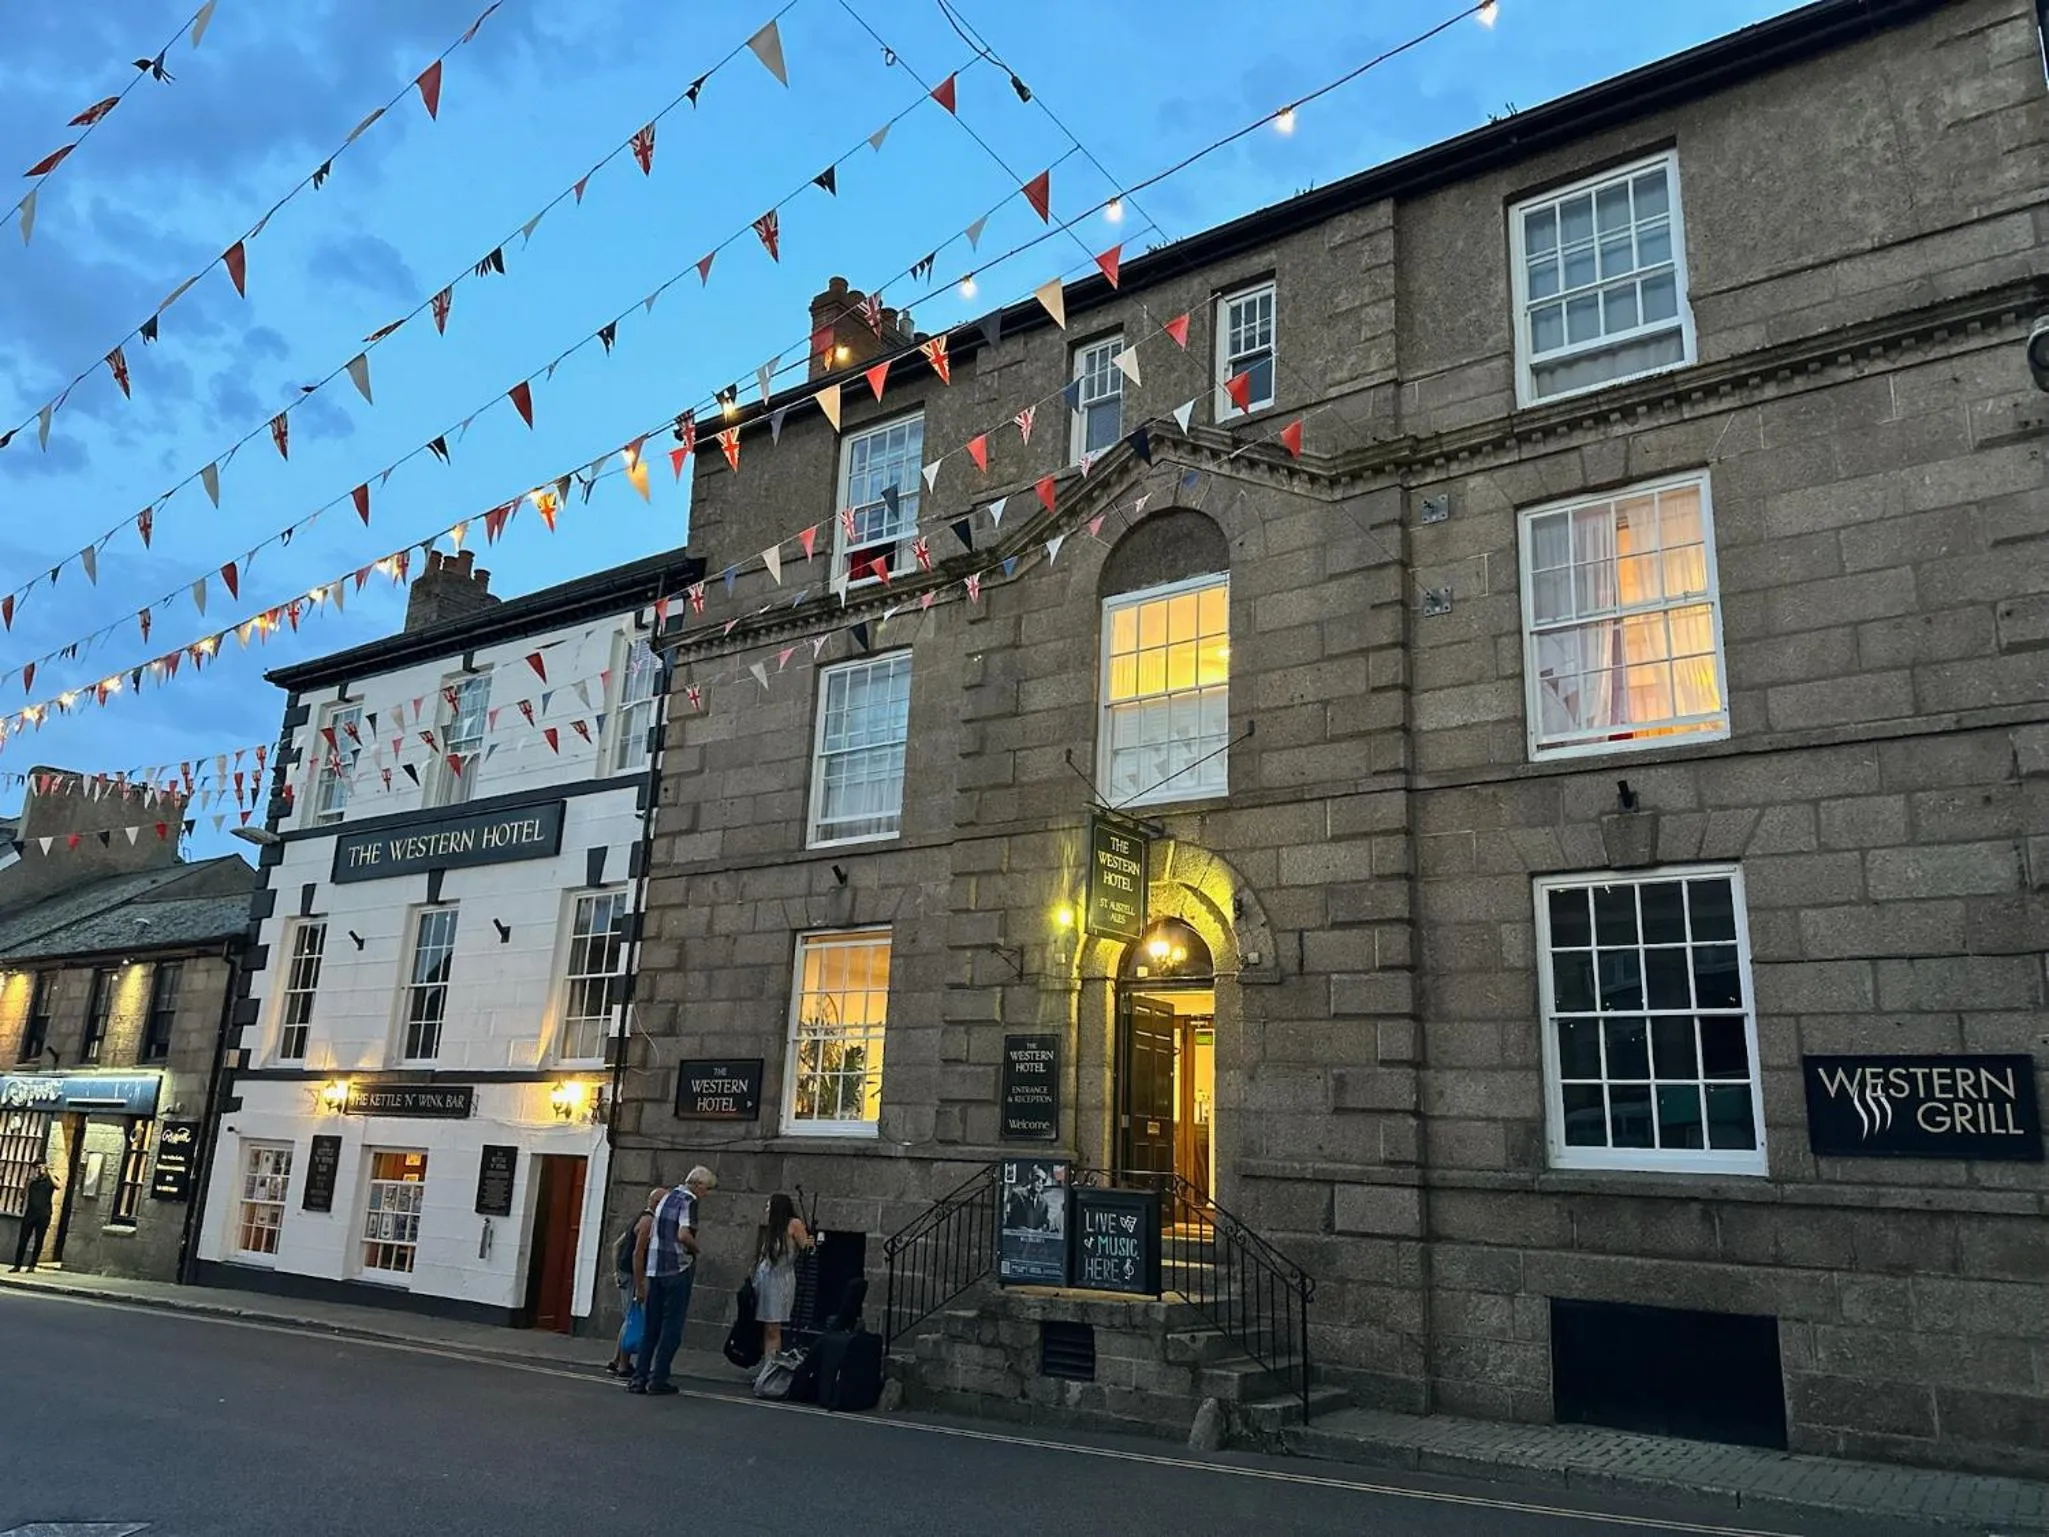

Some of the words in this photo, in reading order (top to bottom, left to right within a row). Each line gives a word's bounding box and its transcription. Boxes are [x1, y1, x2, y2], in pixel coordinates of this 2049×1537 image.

[349, 842, 382, 868] THE
[389, 828, 476, 861] WESTERN
[481, 818, 545, 849] HOTEL
[1110, 836, 1129, 855] THE
[1098, 850, 1141, 877] WESTERN
[1103, 870, 1134, 892] HOTEL
[1110, 911, 1127, 925] ALES
[1010, 1050, 1055, 1061] WESTERN
[713, 1067, 728, 1076] THE
[1015, 1062, 1047, 1073] HOTEL
[690, 1079, 748, 1094] WESTERN
[1012, 1085, 1048, 1094] ENTRANCE
[1817, 1067, 2016, 1100] WESTERN
[370, 1093, 402, 1107] KETTLE
[419, 1095, 443, 1108] WINK
[446, 1095, 465, 1109] BAR
[697, 1097, 737, 1112] HOTEL
[1014, 1095, 1053, 1103] RECEPTION
[1008, 1119, 1050, 1129] Welcome
[1916, 1102, 2025, 1135] GRILL
[1084, 1208, 1117, 1234] LIVE
[1083, 1256, 1120, 1282] HERE
